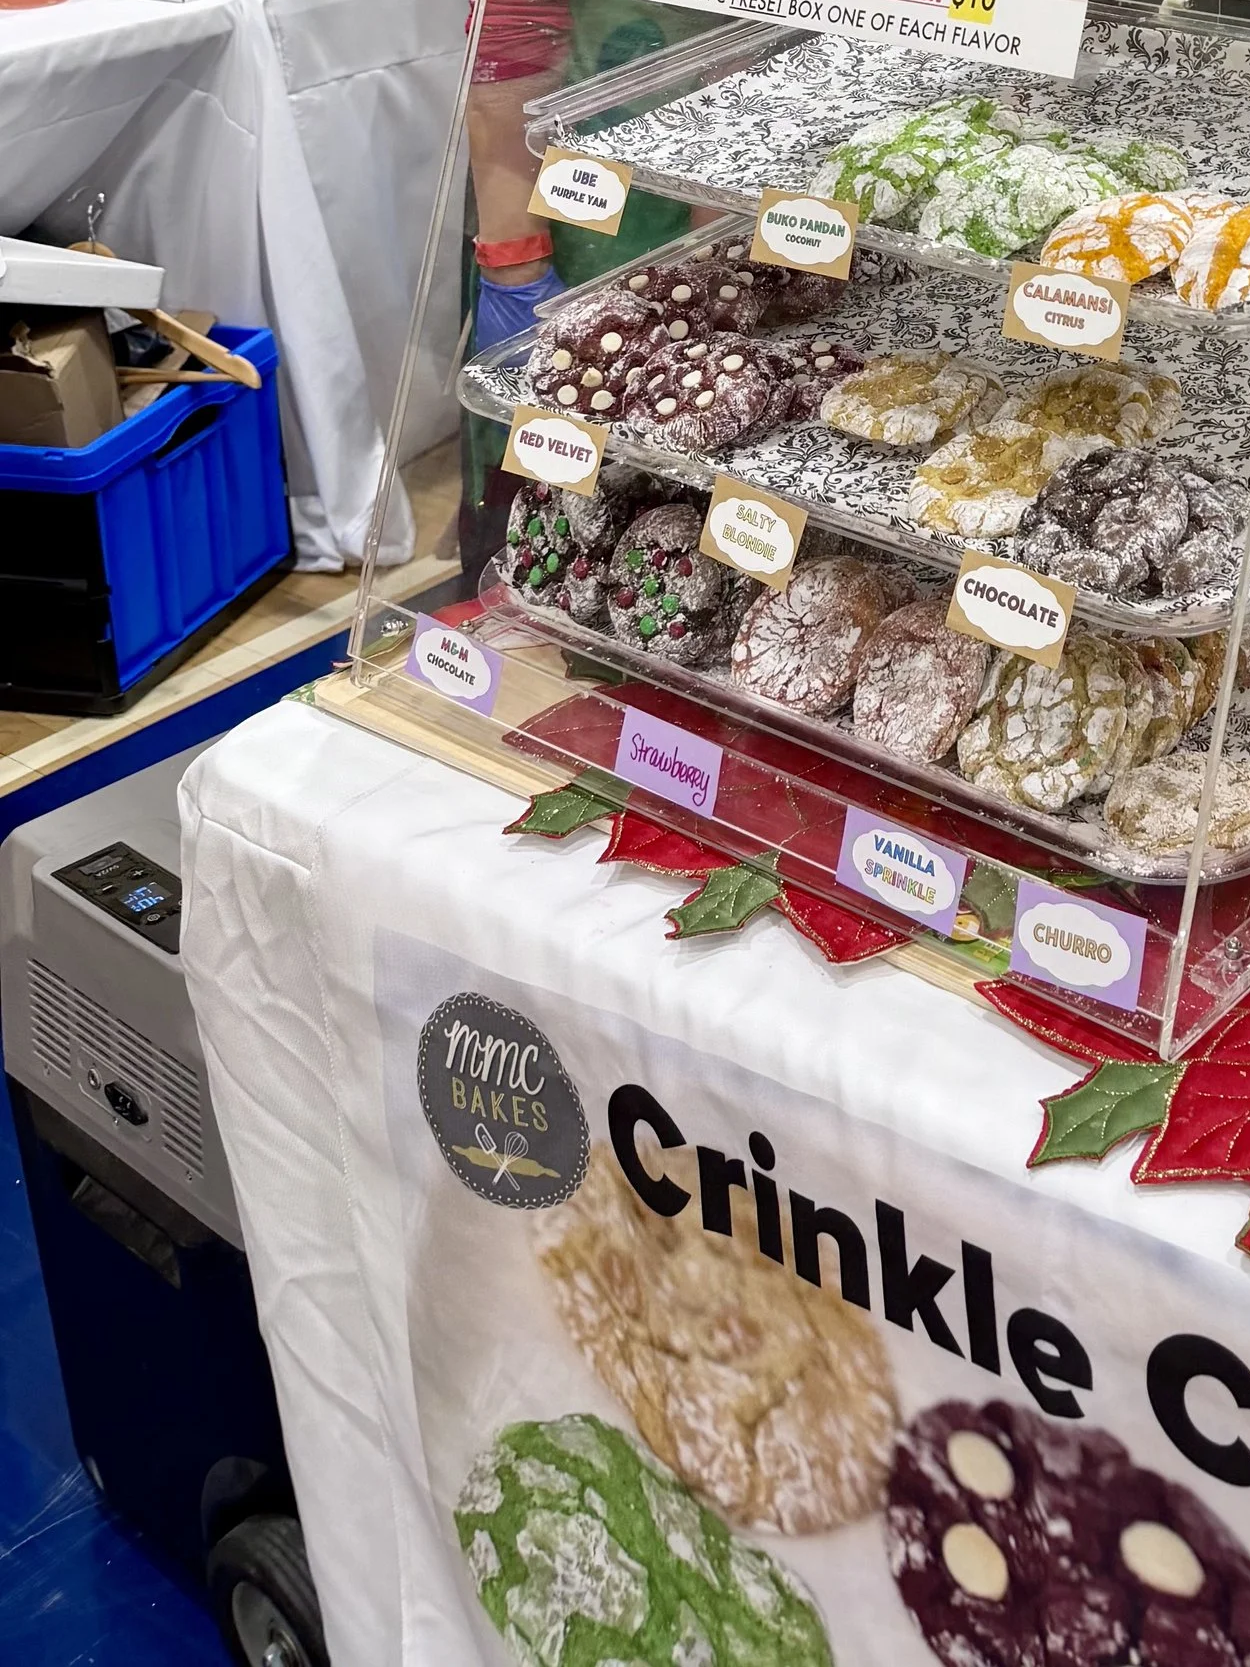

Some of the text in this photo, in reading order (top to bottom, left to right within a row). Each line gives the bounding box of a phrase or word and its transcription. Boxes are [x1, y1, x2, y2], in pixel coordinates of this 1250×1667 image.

[788, 0, 821, 21] BOX
[828, 6, 865, 28] ONE
[870, 13, 895, 33] OF
[899, 16, 946, 43] EACH
[952, 26, 1022, 56] FLAVOR
[573, 169, 598, 188] UBE
[550, 185, 608, 209] PURPLE YAM
[767, 211, 846, 238] BUKO PANDAN
[785, 233, 822, 248] COCONUT
[1023, 282, 1113, 315] CALAMANSI
[1045, 311, 1085, 330] CITRUS
[519, 430, 593, 463] RED VELVET
[736, 504, 777, 532] SALTY
[722, 524, 778, 561] BLONDIE
[964, 578, 1059, 628] CHOCOLATE
[440, 636, 469, 663] M&M
[426, 652, 476, 686] CHOCOLATE
[874, 834, 935, 877] VANILLA
[864, 858, 936, 905] SPRINKLE
[1033, 923, 1112, 964] CHURRO
[452, 1076, 549, 1132] BAKES
[607, 1082, 1093, 1419] Crinkle
